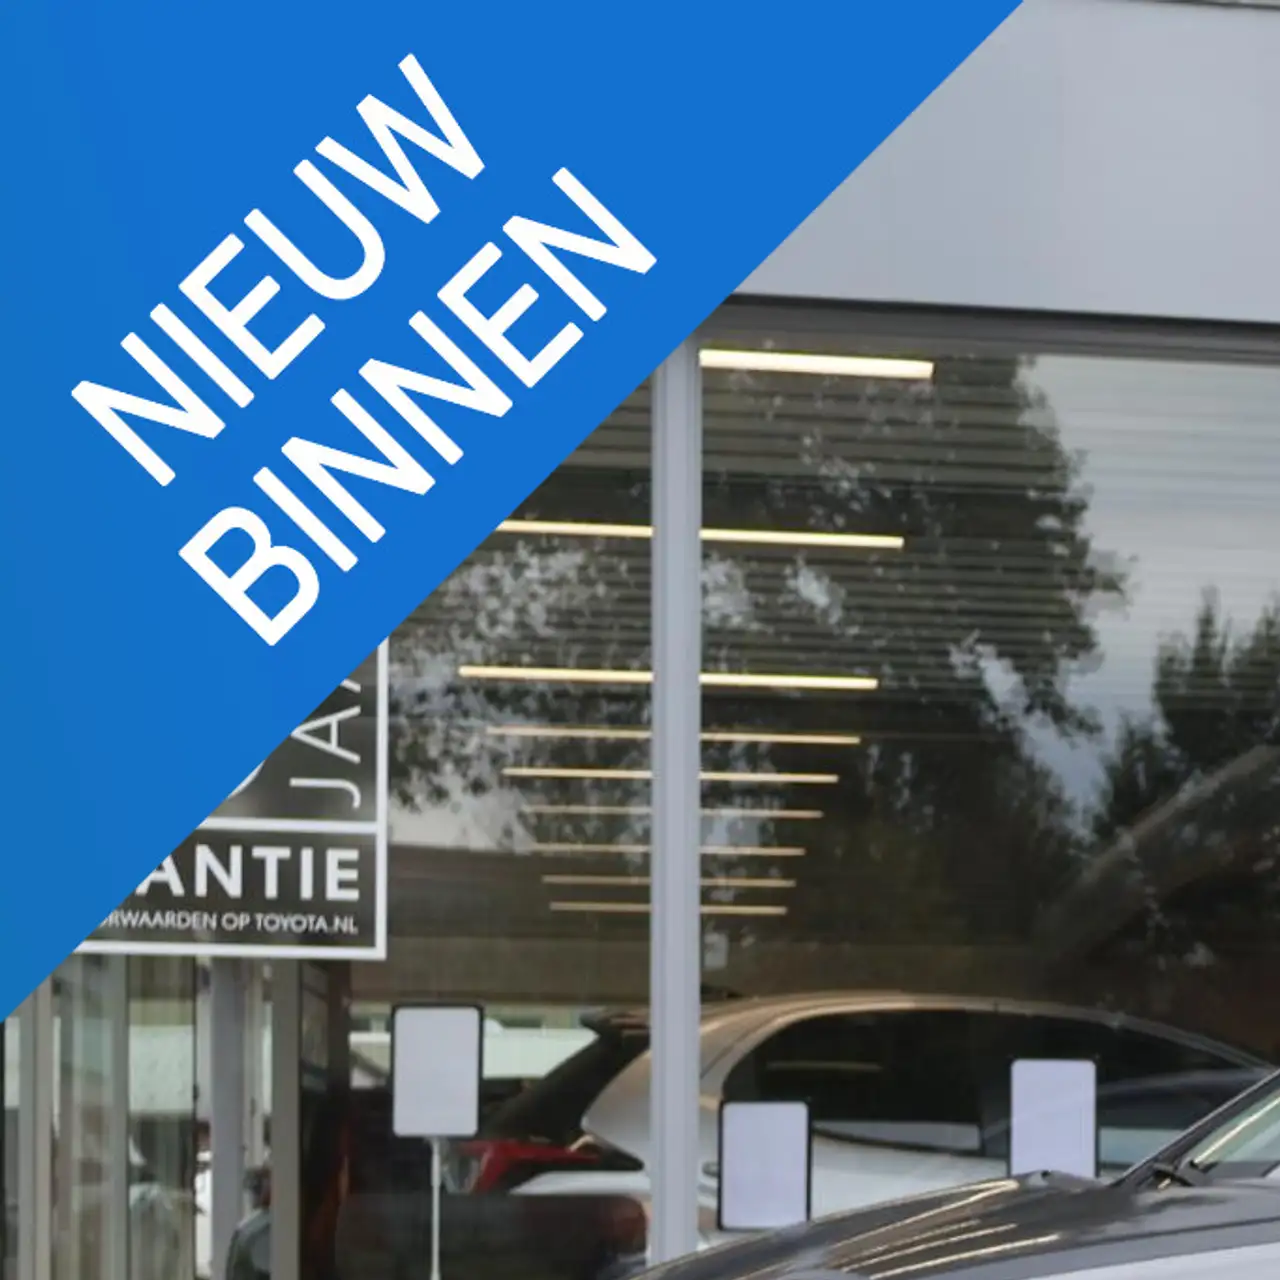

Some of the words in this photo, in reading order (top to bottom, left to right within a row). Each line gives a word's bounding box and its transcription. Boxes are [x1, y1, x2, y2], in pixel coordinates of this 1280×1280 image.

[289, 678, 361, 808] JA
[221, 913, 250, 932] OP
[255, 912, 359, 935] TOYOTA.NL
